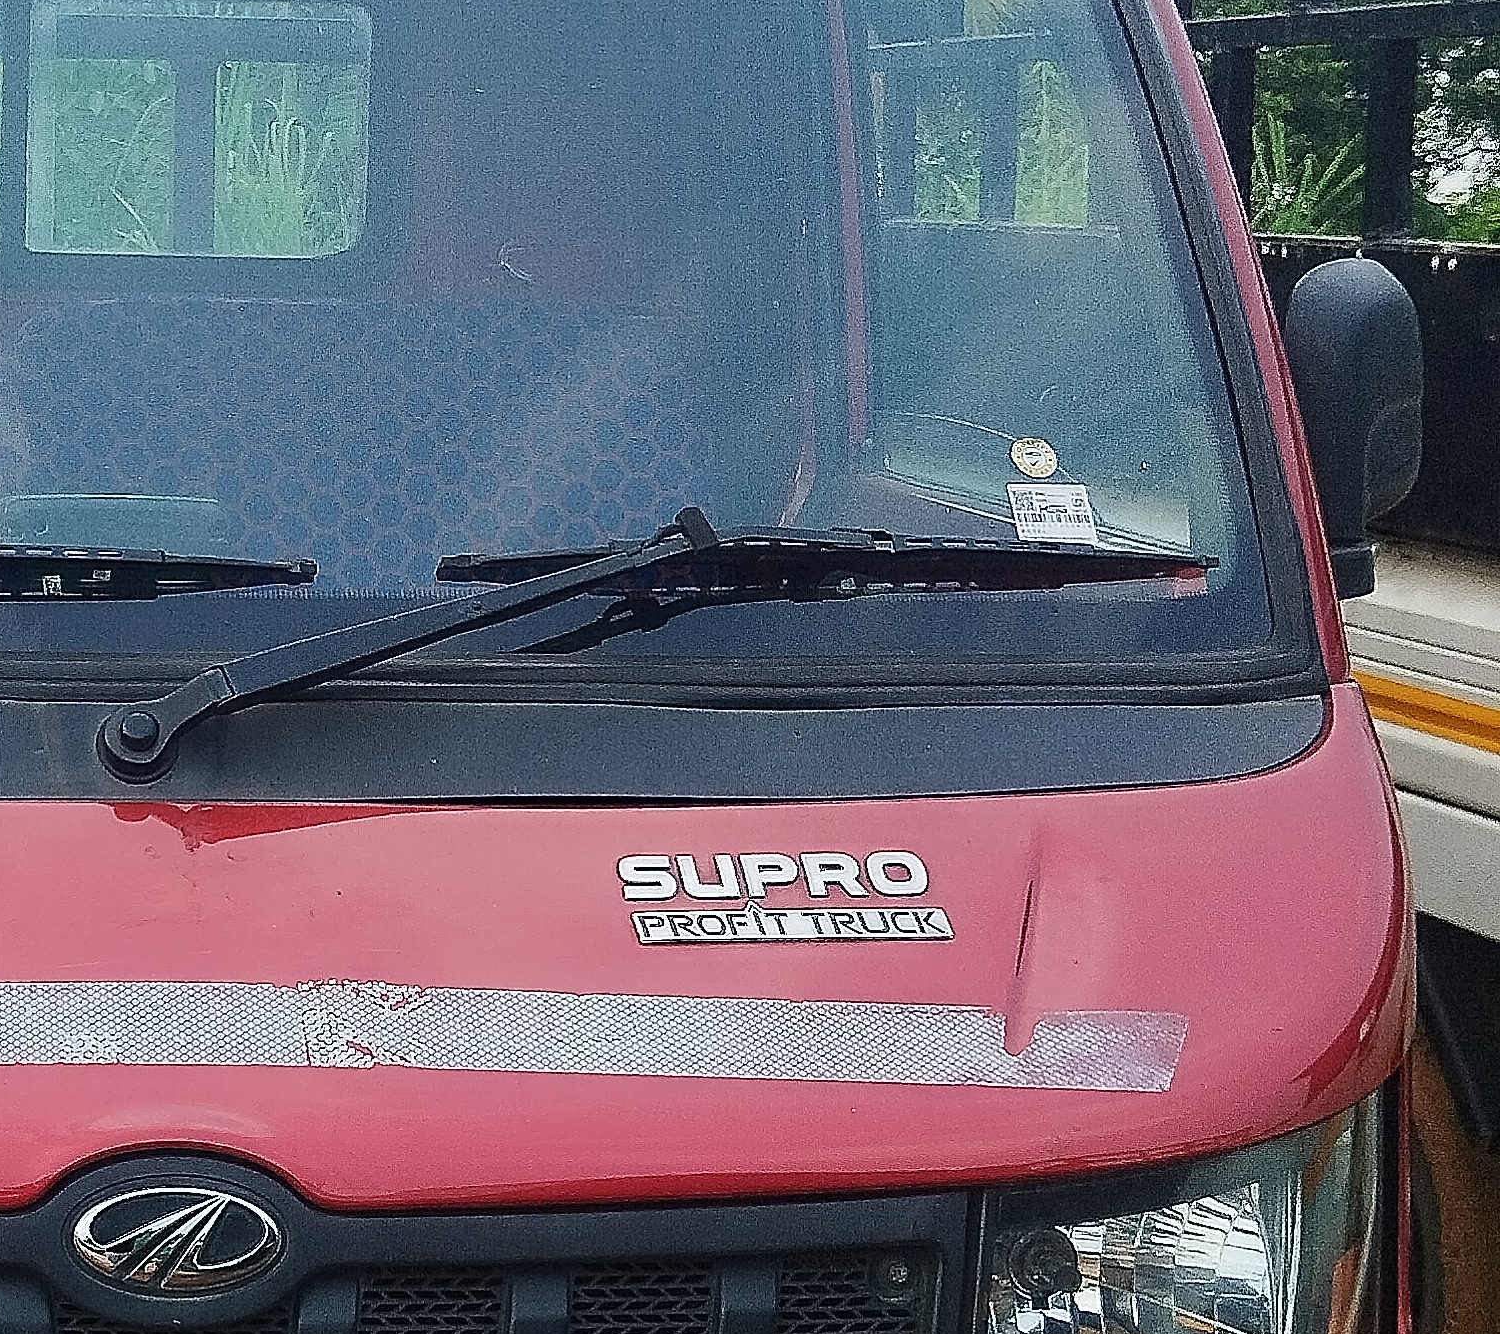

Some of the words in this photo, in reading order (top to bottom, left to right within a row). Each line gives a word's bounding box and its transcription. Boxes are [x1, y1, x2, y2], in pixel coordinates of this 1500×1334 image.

[617, 850, 929, 900] SUPRO
[640, 909, 790, 938] PROFIT
[800, 909, 948, 936] TRUCK
